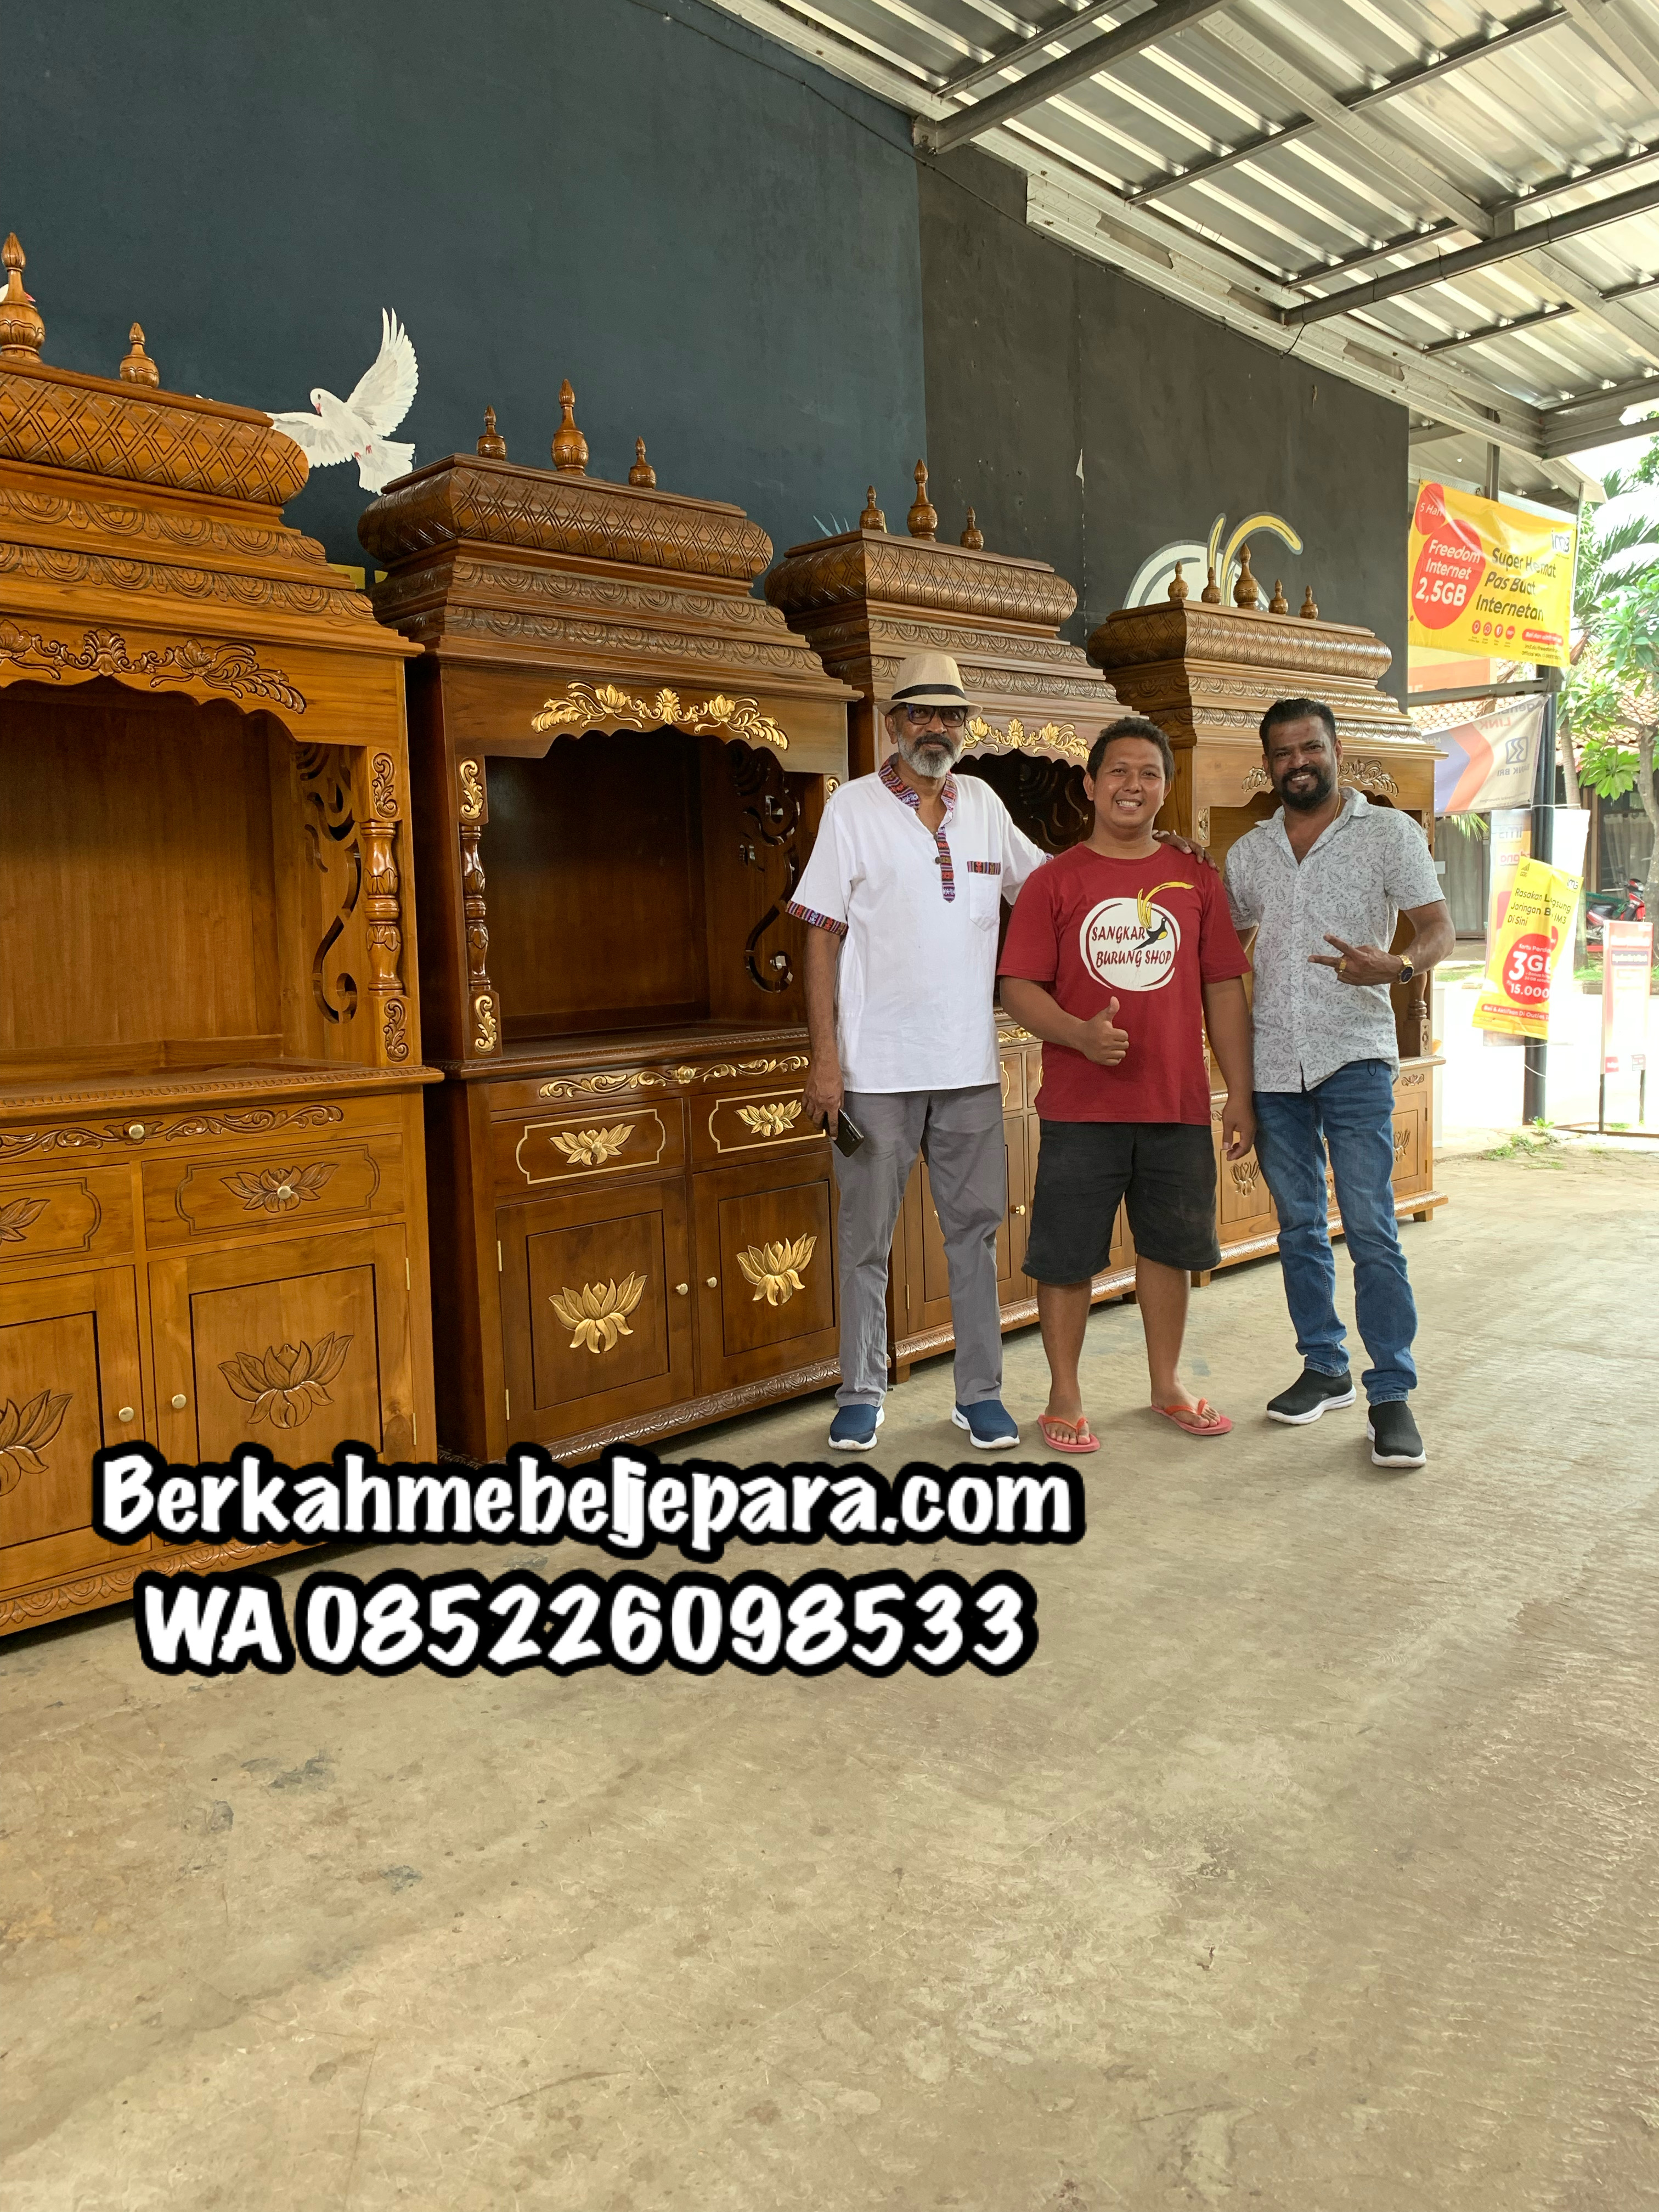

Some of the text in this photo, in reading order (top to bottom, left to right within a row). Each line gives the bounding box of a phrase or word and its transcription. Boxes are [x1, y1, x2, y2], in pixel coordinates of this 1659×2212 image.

[1420, 503, 1425, 512] 5
[1429, 539, 1481, 563] Freedom
[1425, 558, 1472, 580] Internet
[1492, 548, 1556, 578] Super Hemat
[1415, 577, 1467, 606] 2,5GB
[1485, 571, 1536, 595] Pas Buat
[1476, 594, 1543, 621] Internetan
[1515, 888, 1542, 901] Rasakan
[1508, 915, 1528, 926] Di Sini
[1511, 902, 1542, 915] Jaringan
[1554, 912, 1567, 924] IM3
[1092, 926, 1145, 943] SANGKAR
[1096, 950, 1172, 967] BURUNG SHOP
[1510, 983, 1550, 998] 15.000
[1497, 1007, 1519, 1015] Aktifkan
